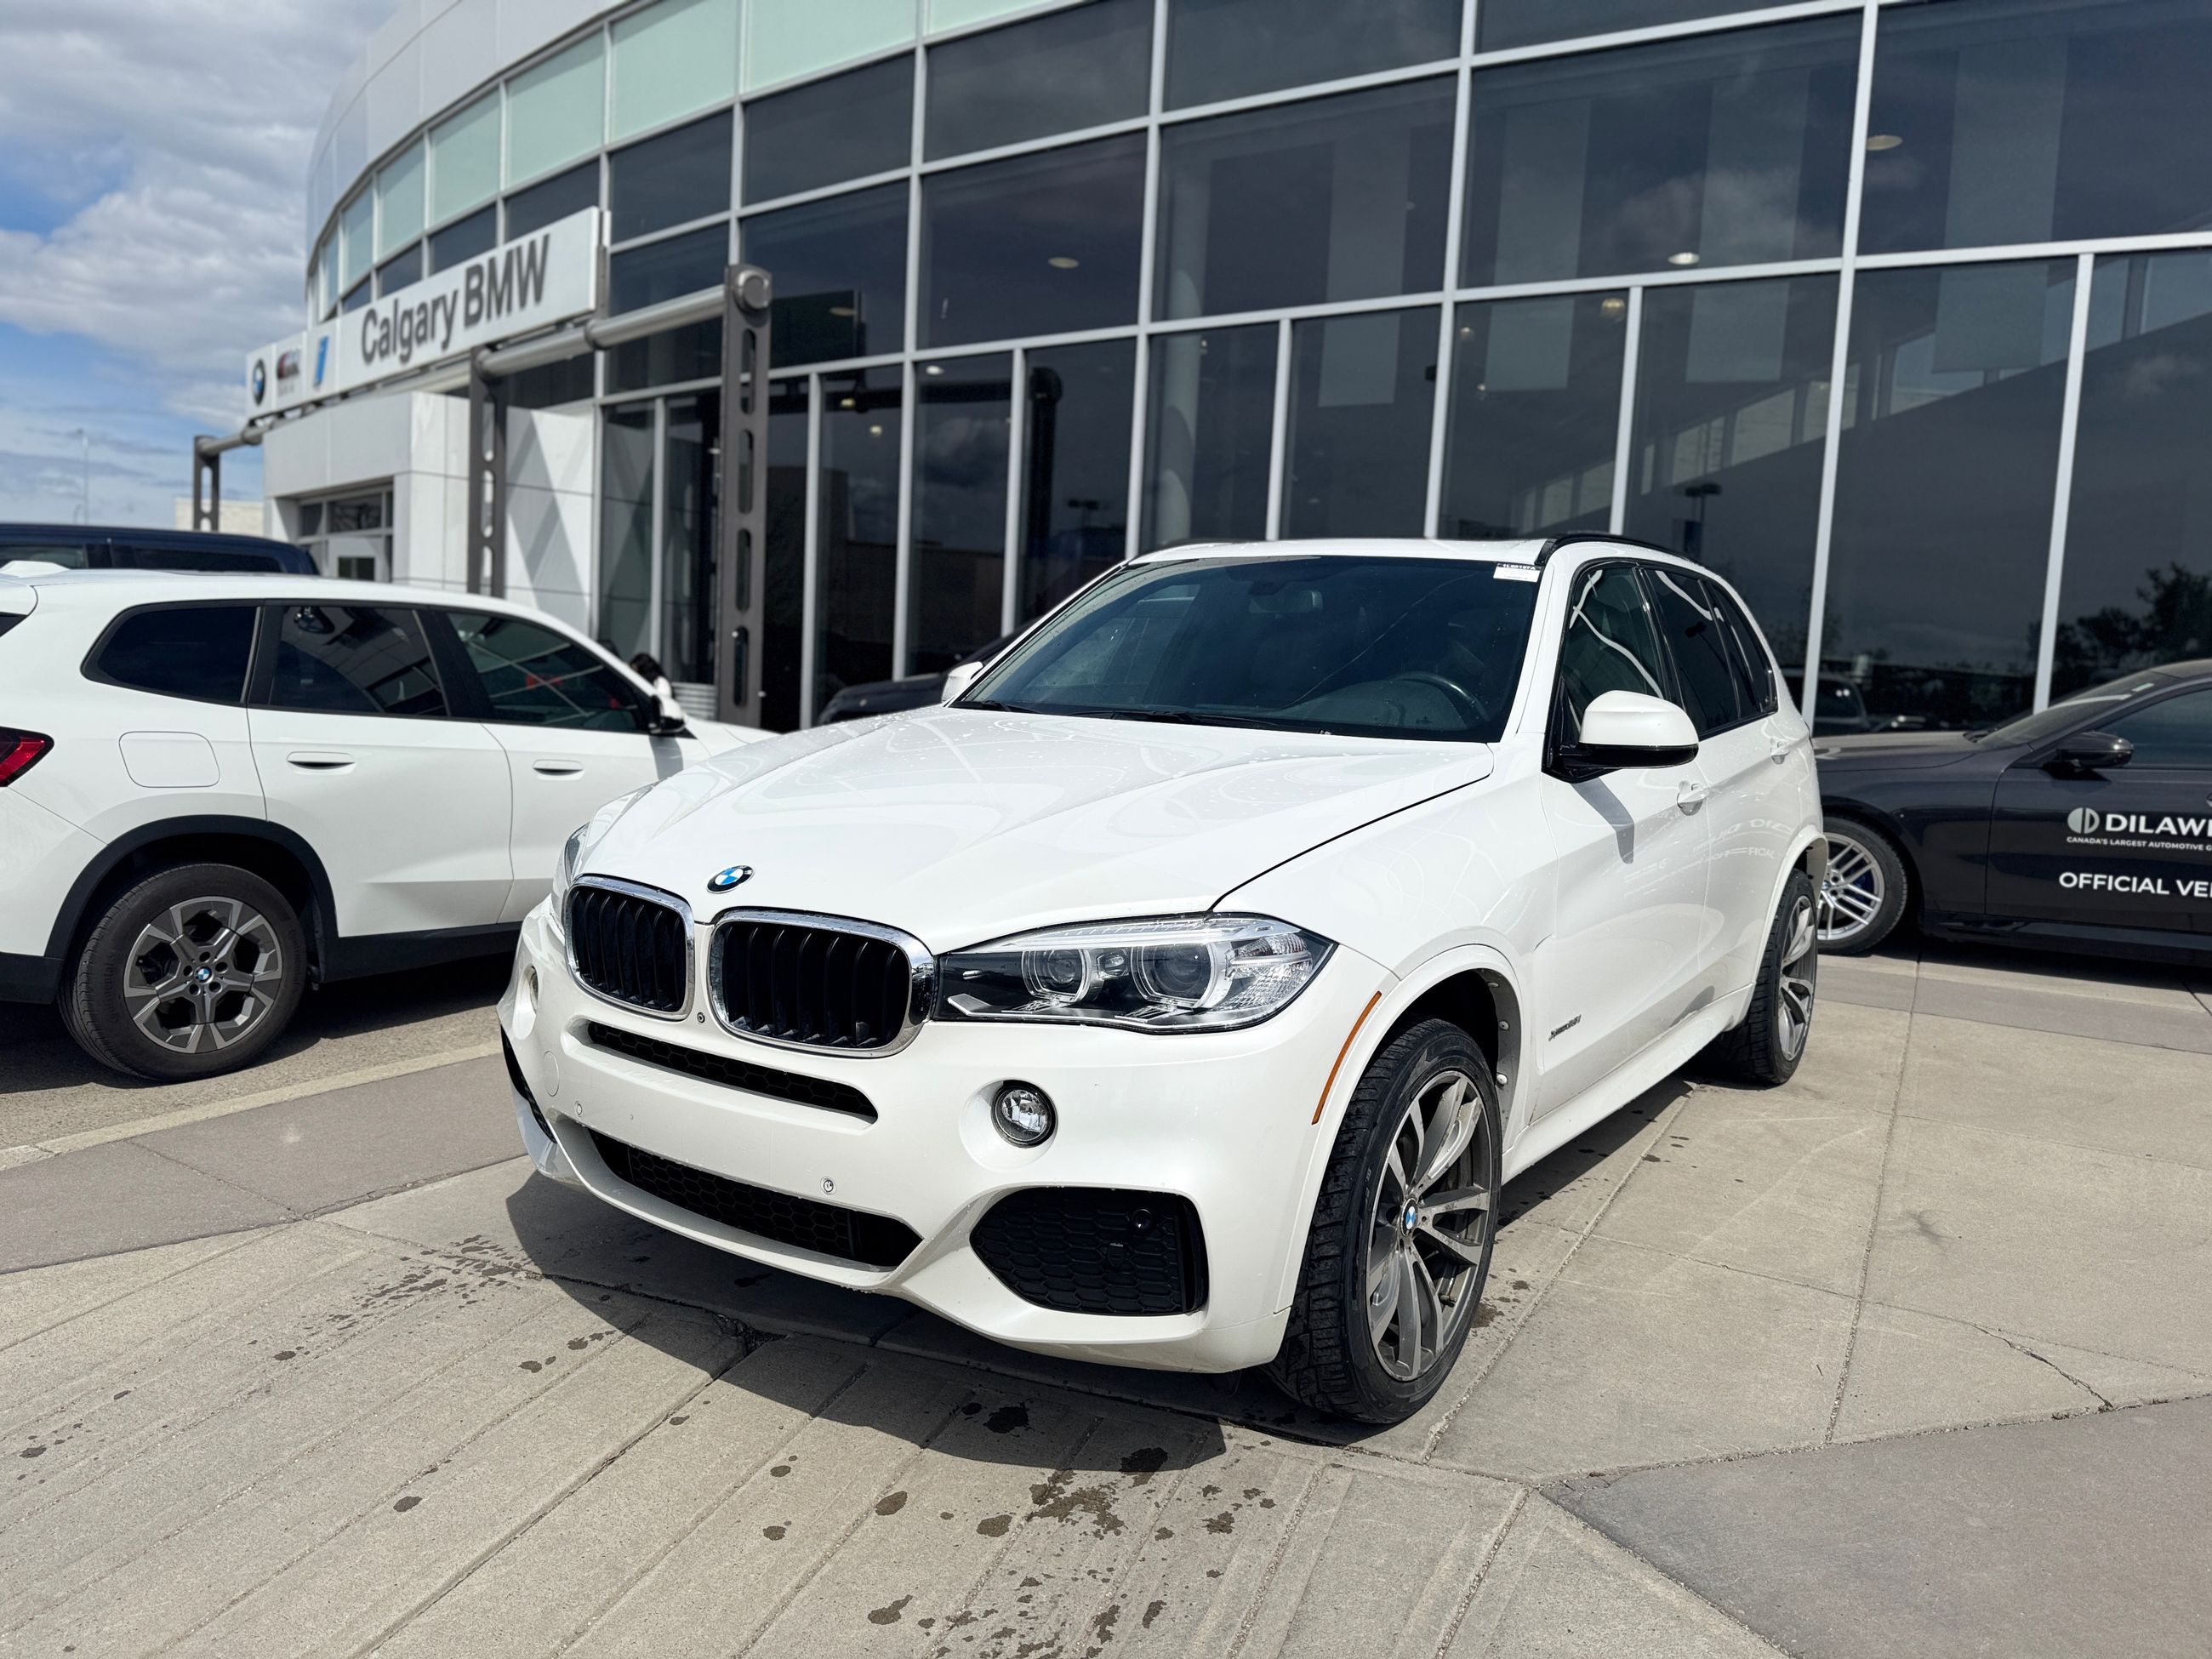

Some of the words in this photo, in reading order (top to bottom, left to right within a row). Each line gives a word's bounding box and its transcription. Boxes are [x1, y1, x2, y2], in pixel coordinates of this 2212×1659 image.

[362, 289, 459, 364] Calgary
[464, 234, 550, 328] BMW
[2067, 836, 2108, 845] CANADA'S
[2110, 839, 2146, 847] LARGEST
[2148, 841, 2203, 851] AUTOMOTIVE
[2059, 872, 2169, 894] OFFICIAL
[2175, 879, 2212, 898] VE
